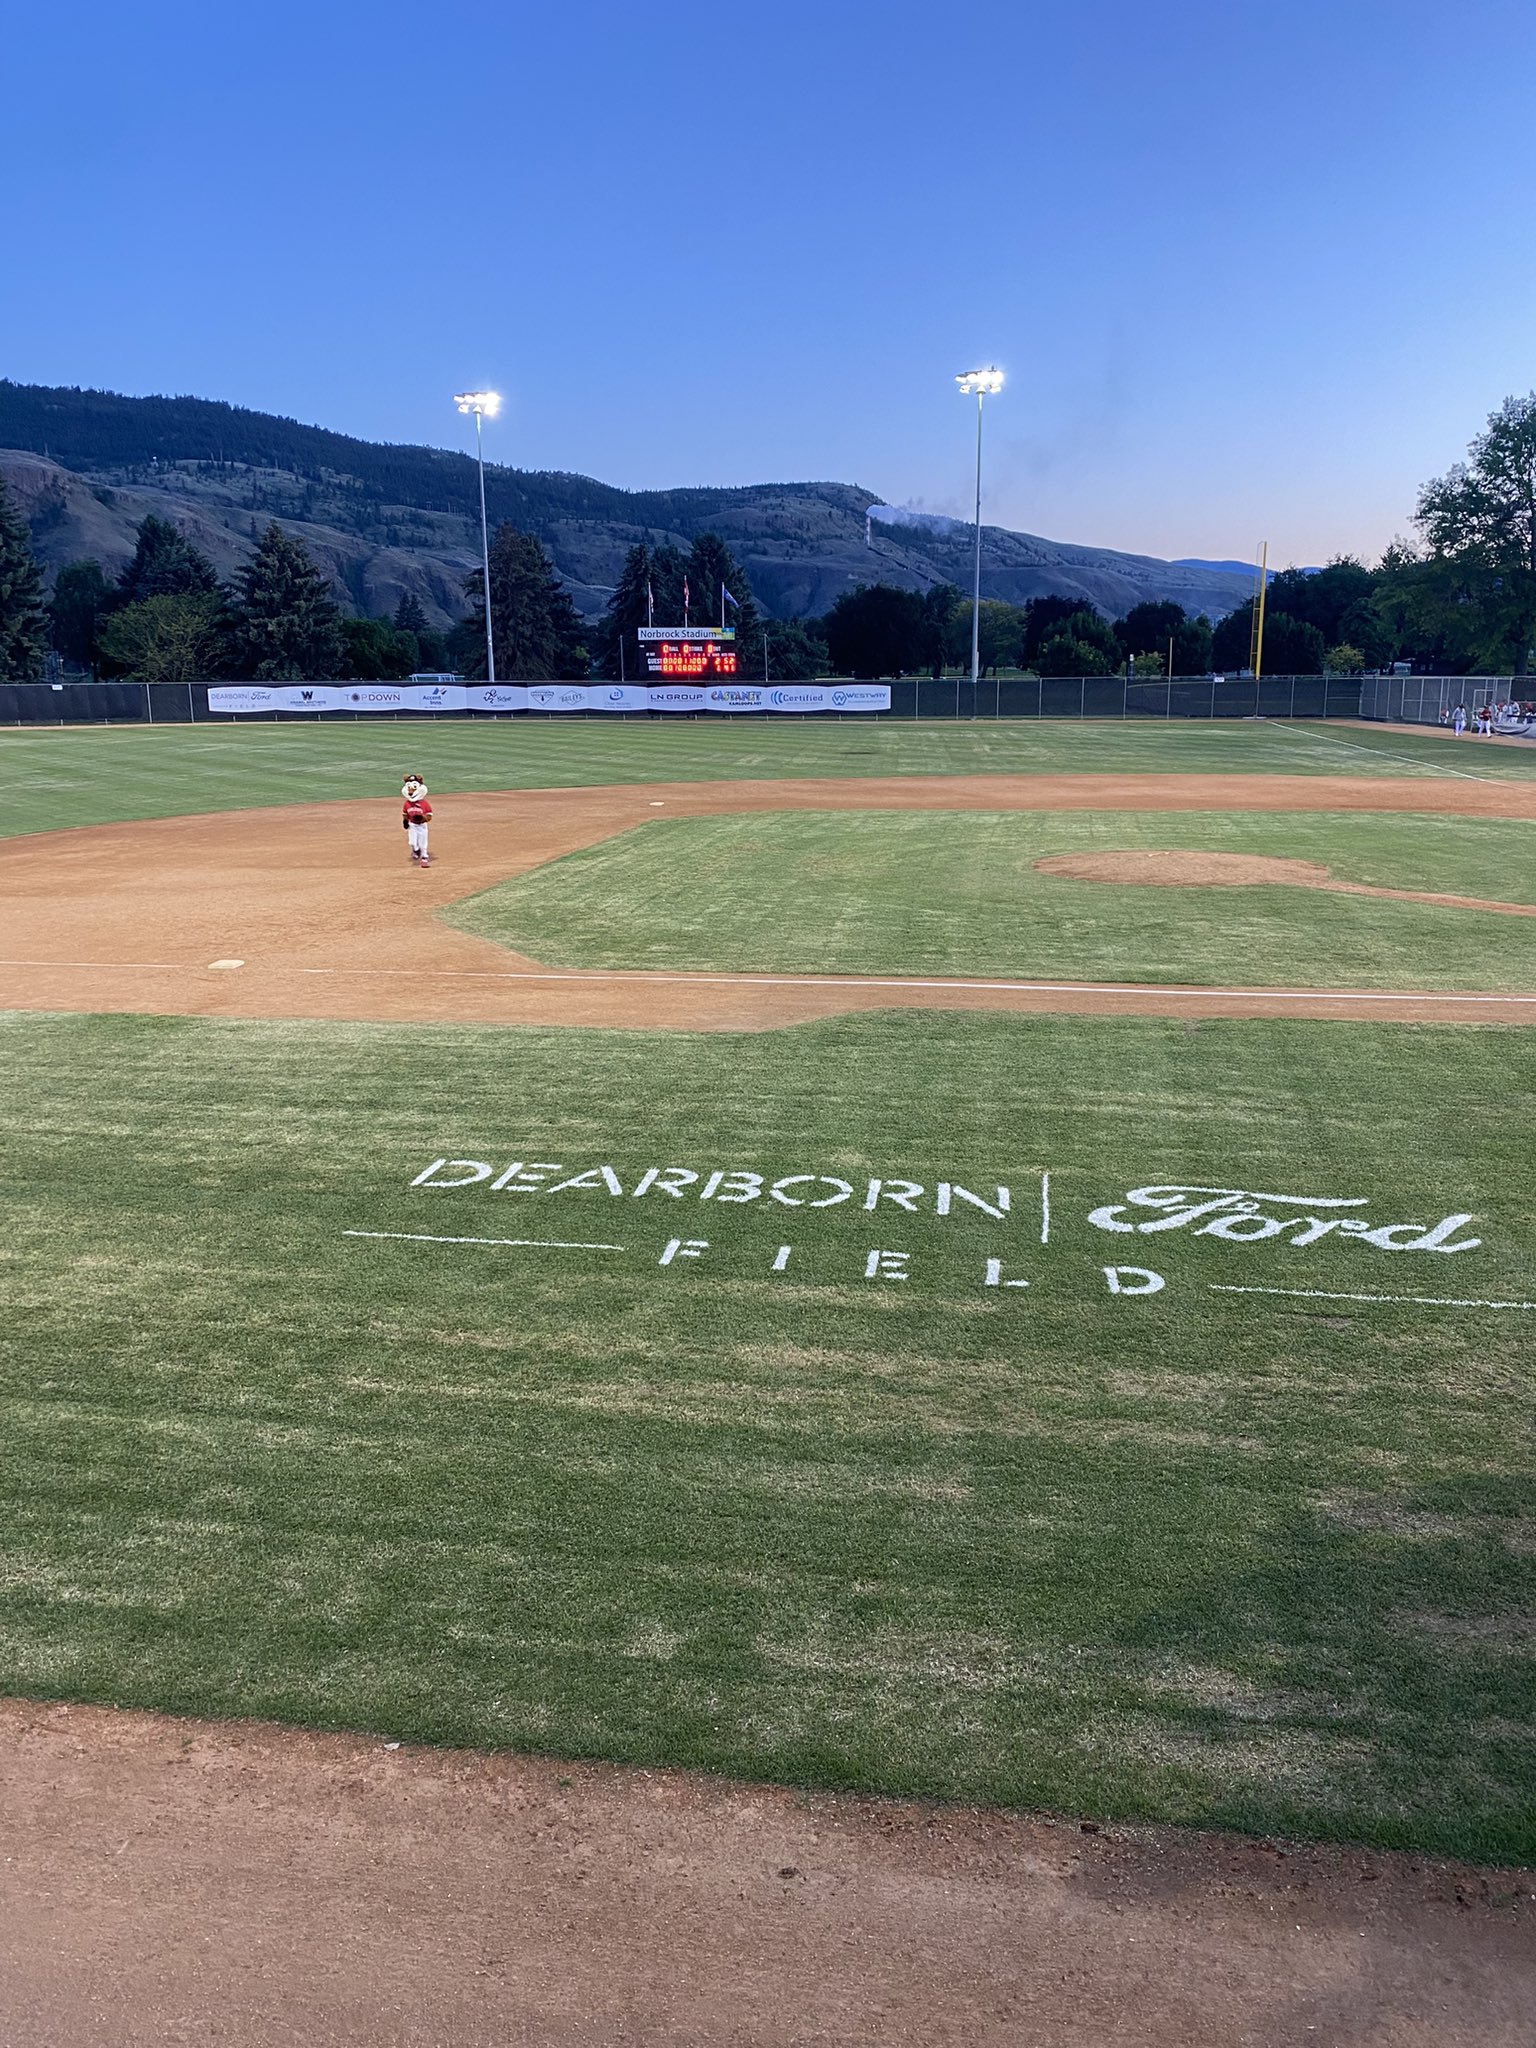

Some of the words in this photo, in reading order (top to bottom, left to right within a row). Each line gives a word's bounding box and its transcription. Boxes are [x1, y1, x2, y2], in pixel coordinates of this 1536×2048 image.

[640, 629, 680, 638] Norbrock
[681, 629, 717, 638] Stadium
[211, 692, 248, 700] DEARBORN
[250, 691, 272, 701] Ford
[301, 690, 314, 701] W
[711, 690, 762, 701] CASTANET
[783, 693, 824, 702] Certified
[410, 1158, 1012, 1219] DEARBORN
[1087, 1185, 1482, 1254] Ford
